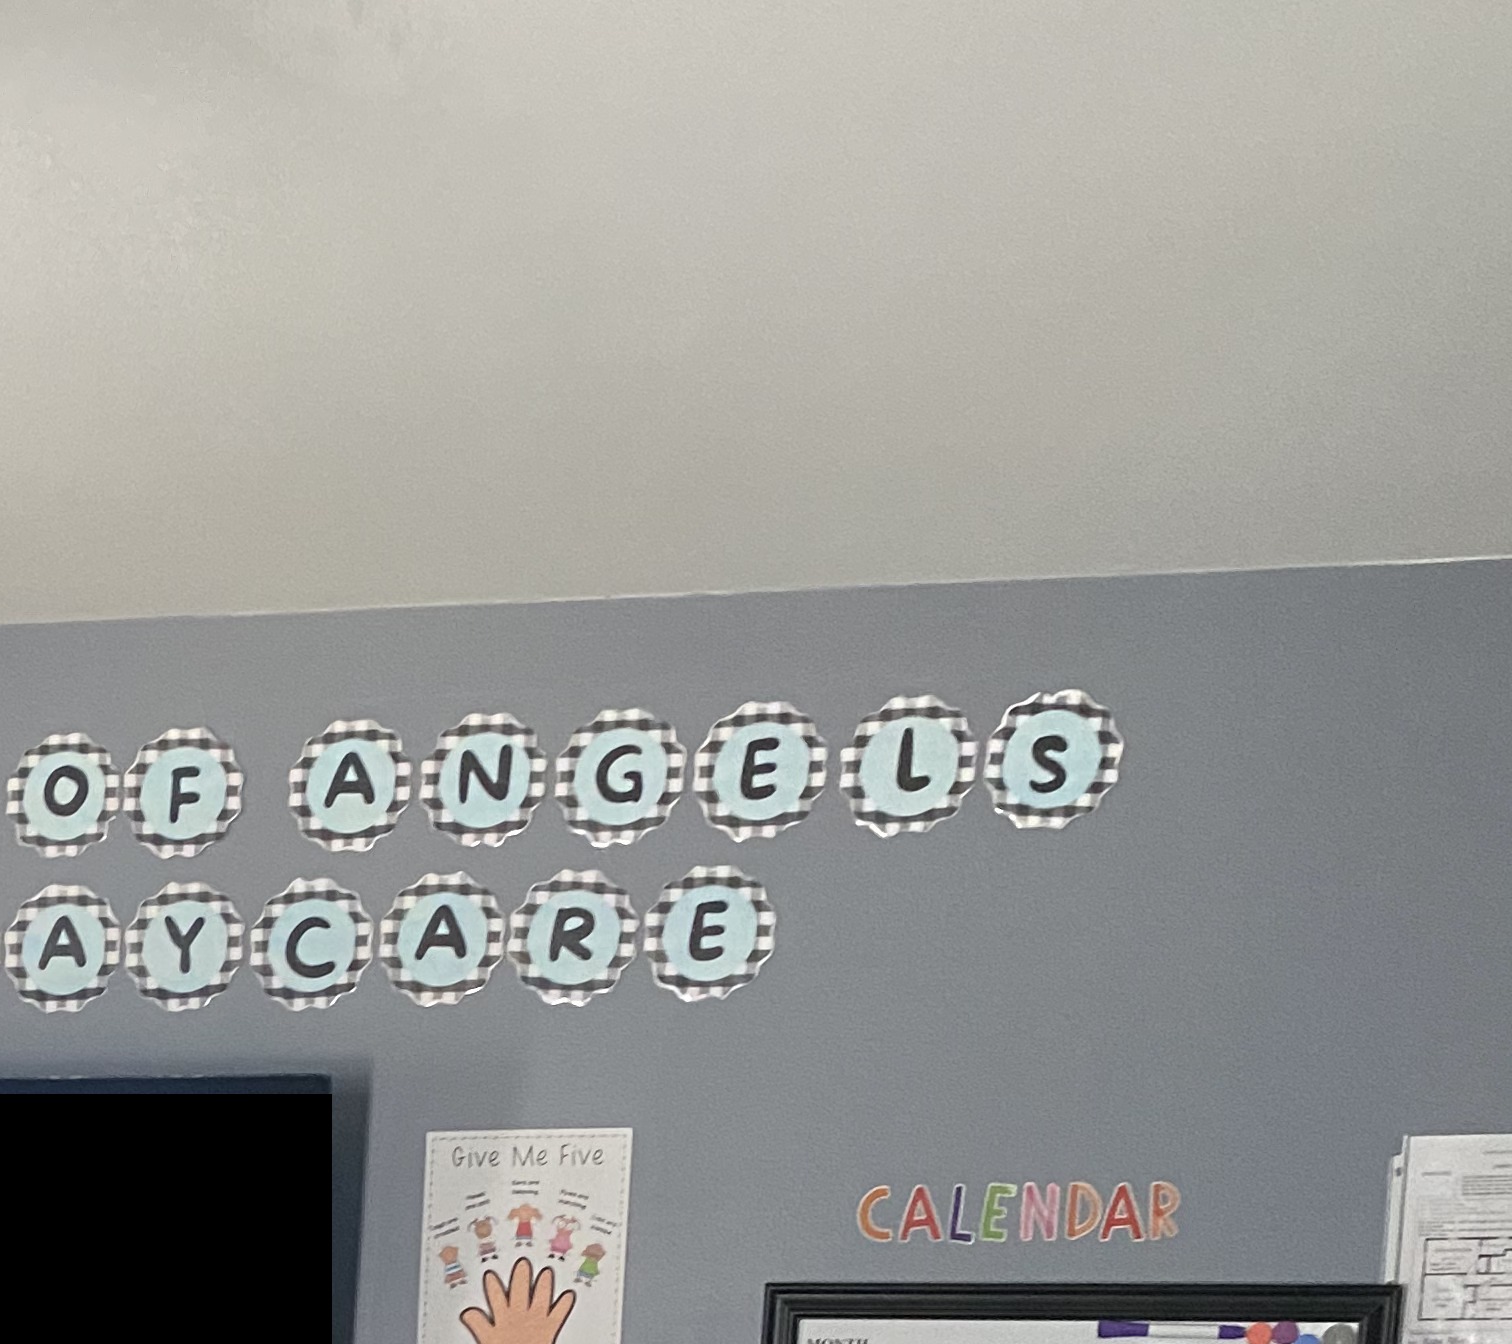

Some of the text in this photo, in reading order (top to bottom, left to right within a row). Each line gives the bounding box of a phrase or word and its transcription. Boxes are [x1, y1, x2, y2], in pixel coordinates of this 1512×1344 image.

[43, 764, 201, 823] OF
[323, 727, 1070, 807] ANGELS
[451, 1143, 604, 1168] Give Me Five
[856, 1181, 1181, 1245] CALENDAR
